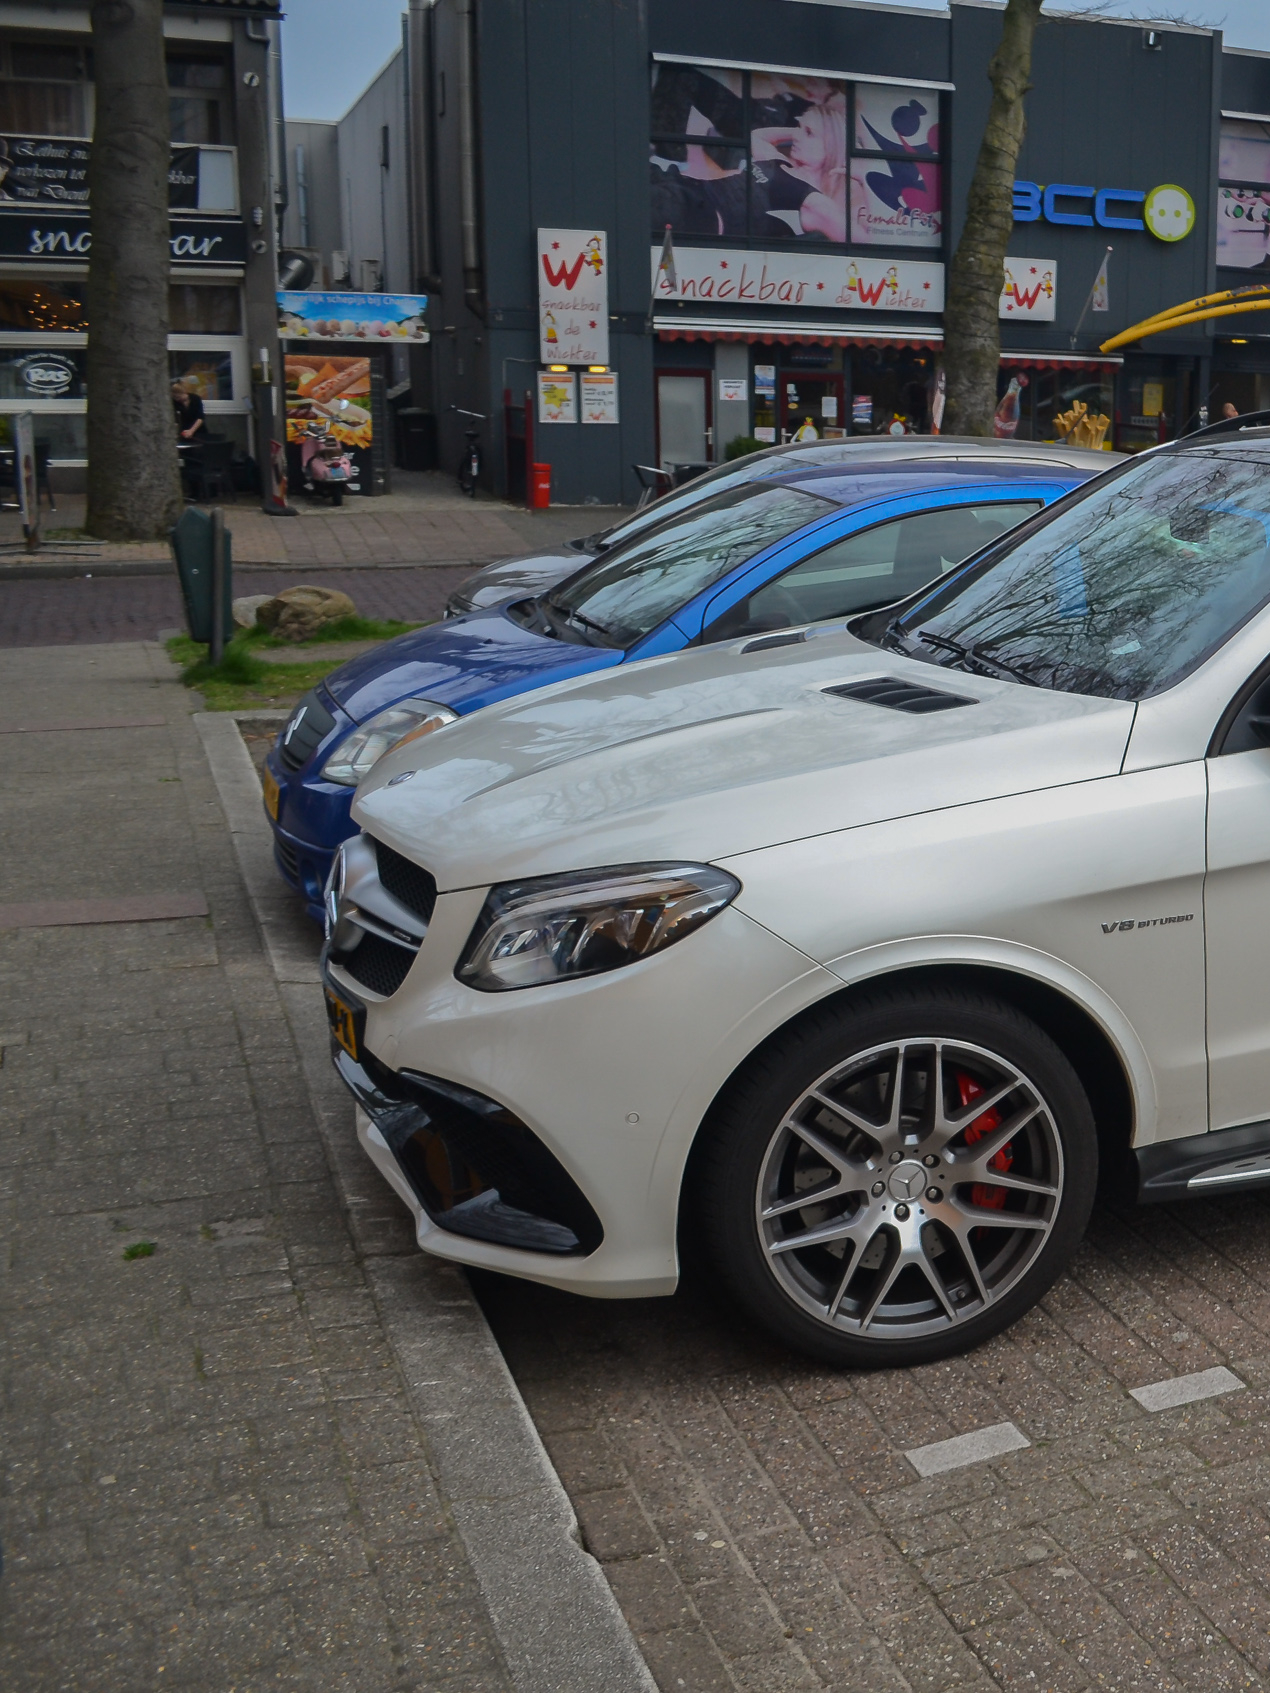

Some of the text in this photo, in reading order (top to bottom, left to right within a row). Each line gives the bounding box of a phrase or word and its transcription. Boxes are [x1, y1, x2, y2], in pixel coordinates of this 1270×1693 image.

[857, 206, 909, 226] Female
[1012, 180, 1145, 231] BCC
[29, 229, 222, 256] snaar
[542, 252, 587, 291] W
[660, 262, 810, 304] snackbar
[835, 286, 851, 304] de
[541, 297, 602, 312] snackbar
[1013, 281, 1042, 310] W
[564, 317, 581, 336] de
[1101, 913, 1194, 934] V8 BITURBO
